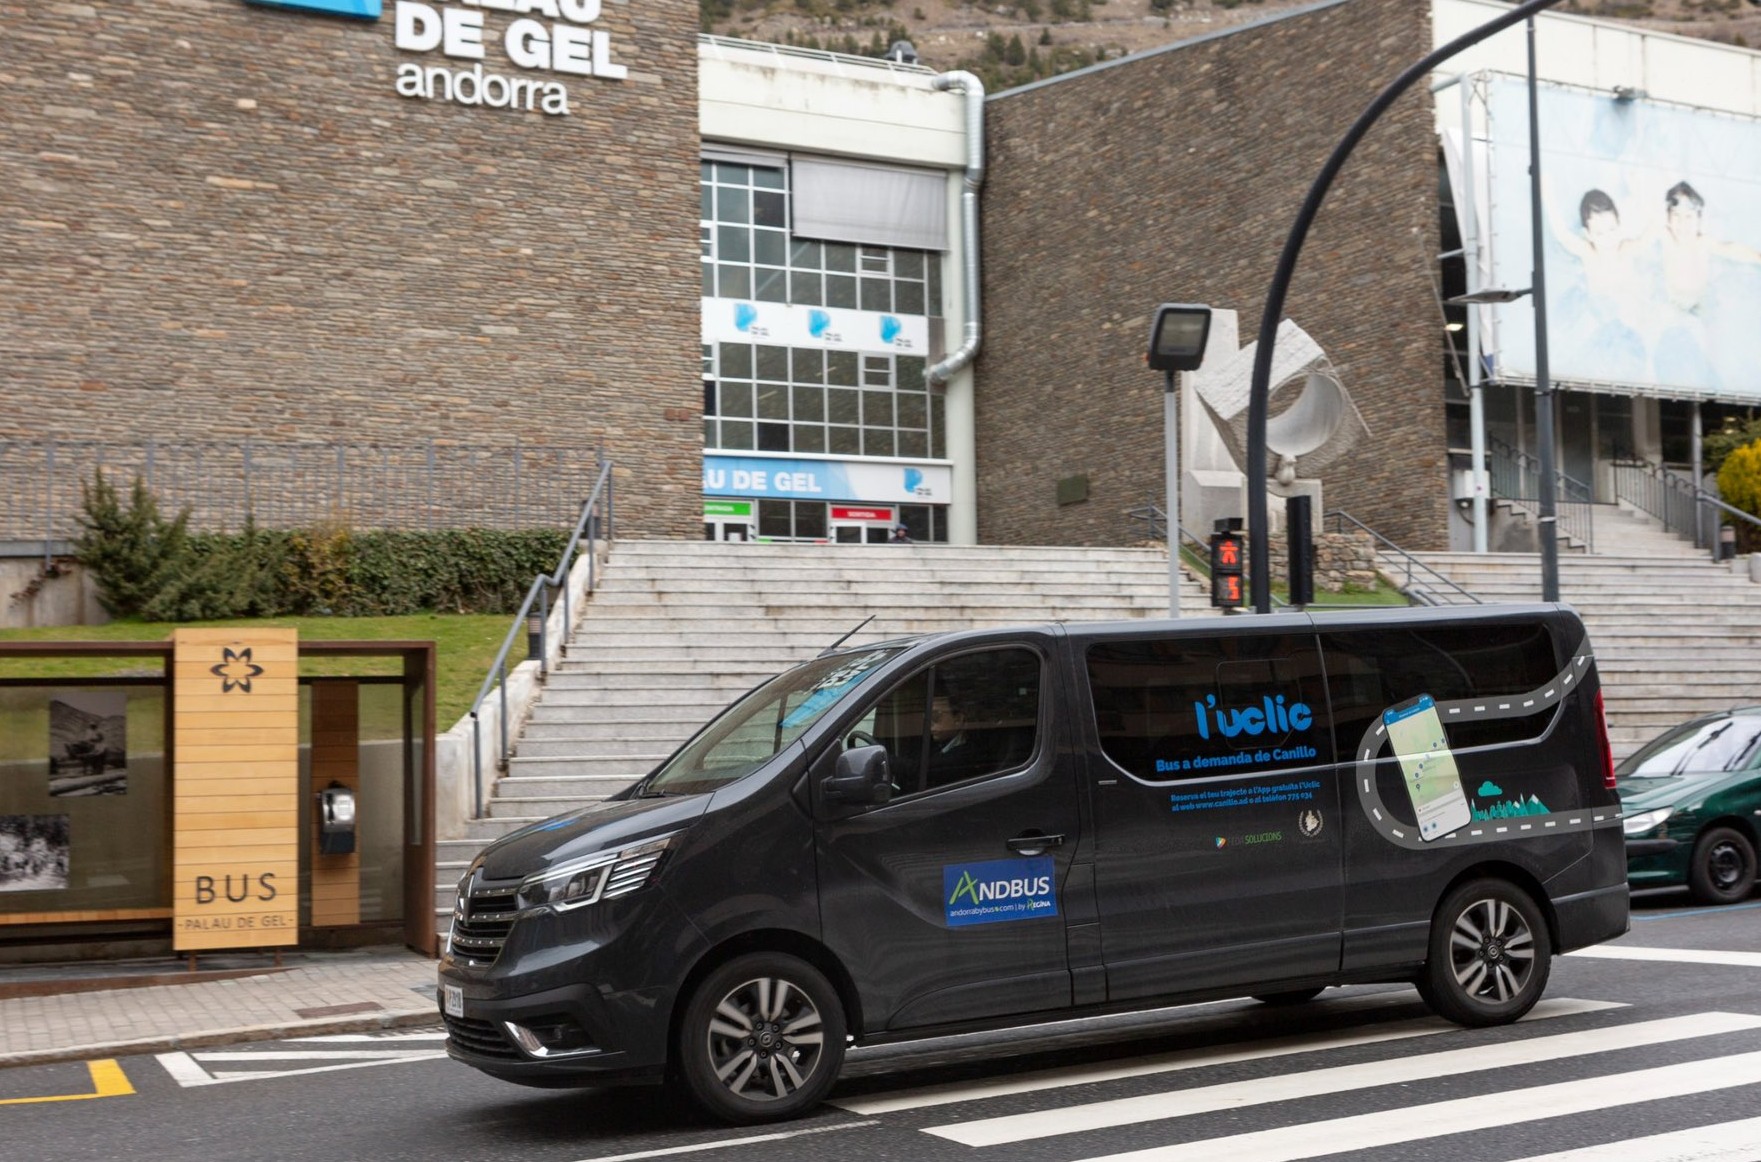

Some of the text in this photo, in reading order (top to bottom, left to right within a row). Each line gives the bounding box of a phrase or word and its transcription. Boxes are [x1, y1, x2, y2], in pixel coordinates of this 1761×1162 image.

[395, 1, 628, 80] DE GEL
[395, 62, 570, 115] andorra
[702, 469, 822, 493] U DE GEL
[1156, 746, 1316, 772] Bus a demanda de Canillo
[1245, 831, 1282, 845] SOLUCIONS
[196, 872, 276, 904] BUS
[949, 870, 1050, 905] ANDBUS
[237, 917, 254, 928] DE
